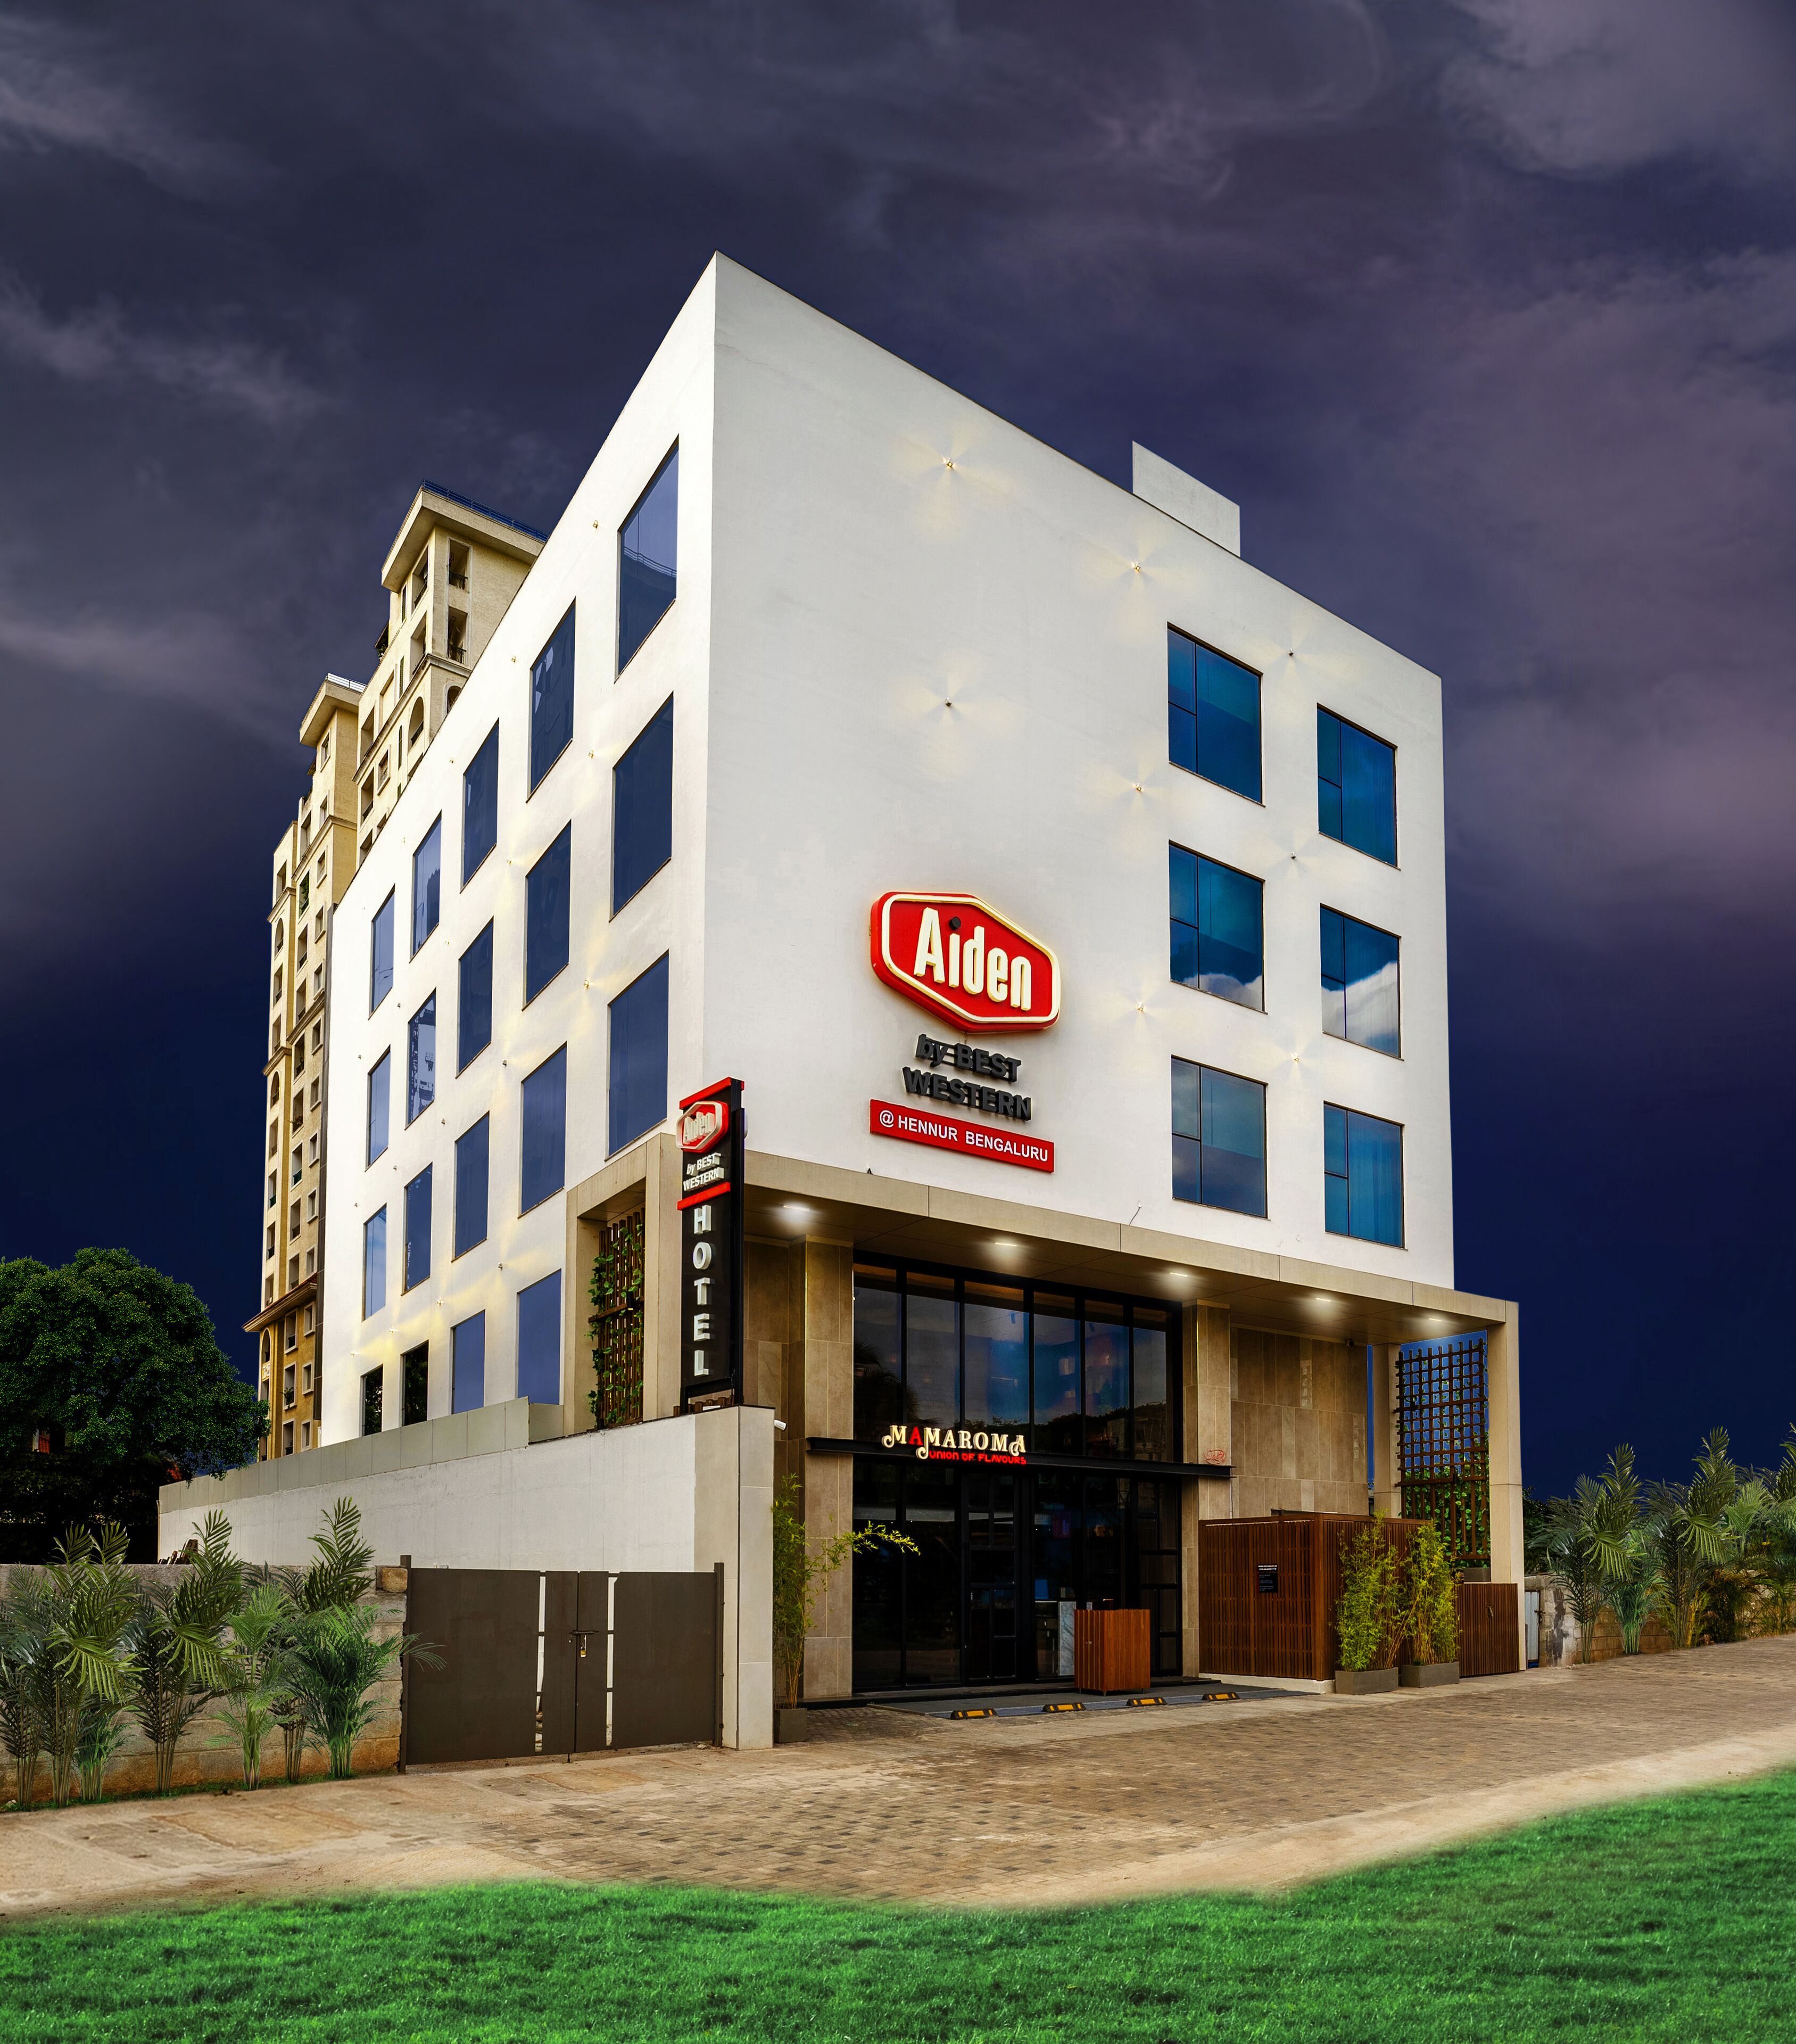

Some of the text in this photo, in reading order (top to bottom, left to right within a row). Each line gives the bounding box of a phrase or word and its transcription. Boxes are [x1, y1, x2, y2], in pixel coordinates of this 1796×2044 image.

[914, 906, 1031, 1011] Aiden
[915, 1033, 1021, 1083] by BEST
[903, 1066, 1031, 1121] WESTERN
[683, 1111, 715, 1144] Aiden
[879, 1110, 1048, 1162] @ HENNUR BENGALURU
[683, 1167, 724, 1191] WESTERN
[686, 1152, 722, 1176] by BEST
[693, 1205, 711, 1377] HOTEL
[881, 1425, 1027, 1460] MAMAROMA
[961, 1452, 975, 1462] OF
[978, 1454, 1027, 1464] FLAVOURS
